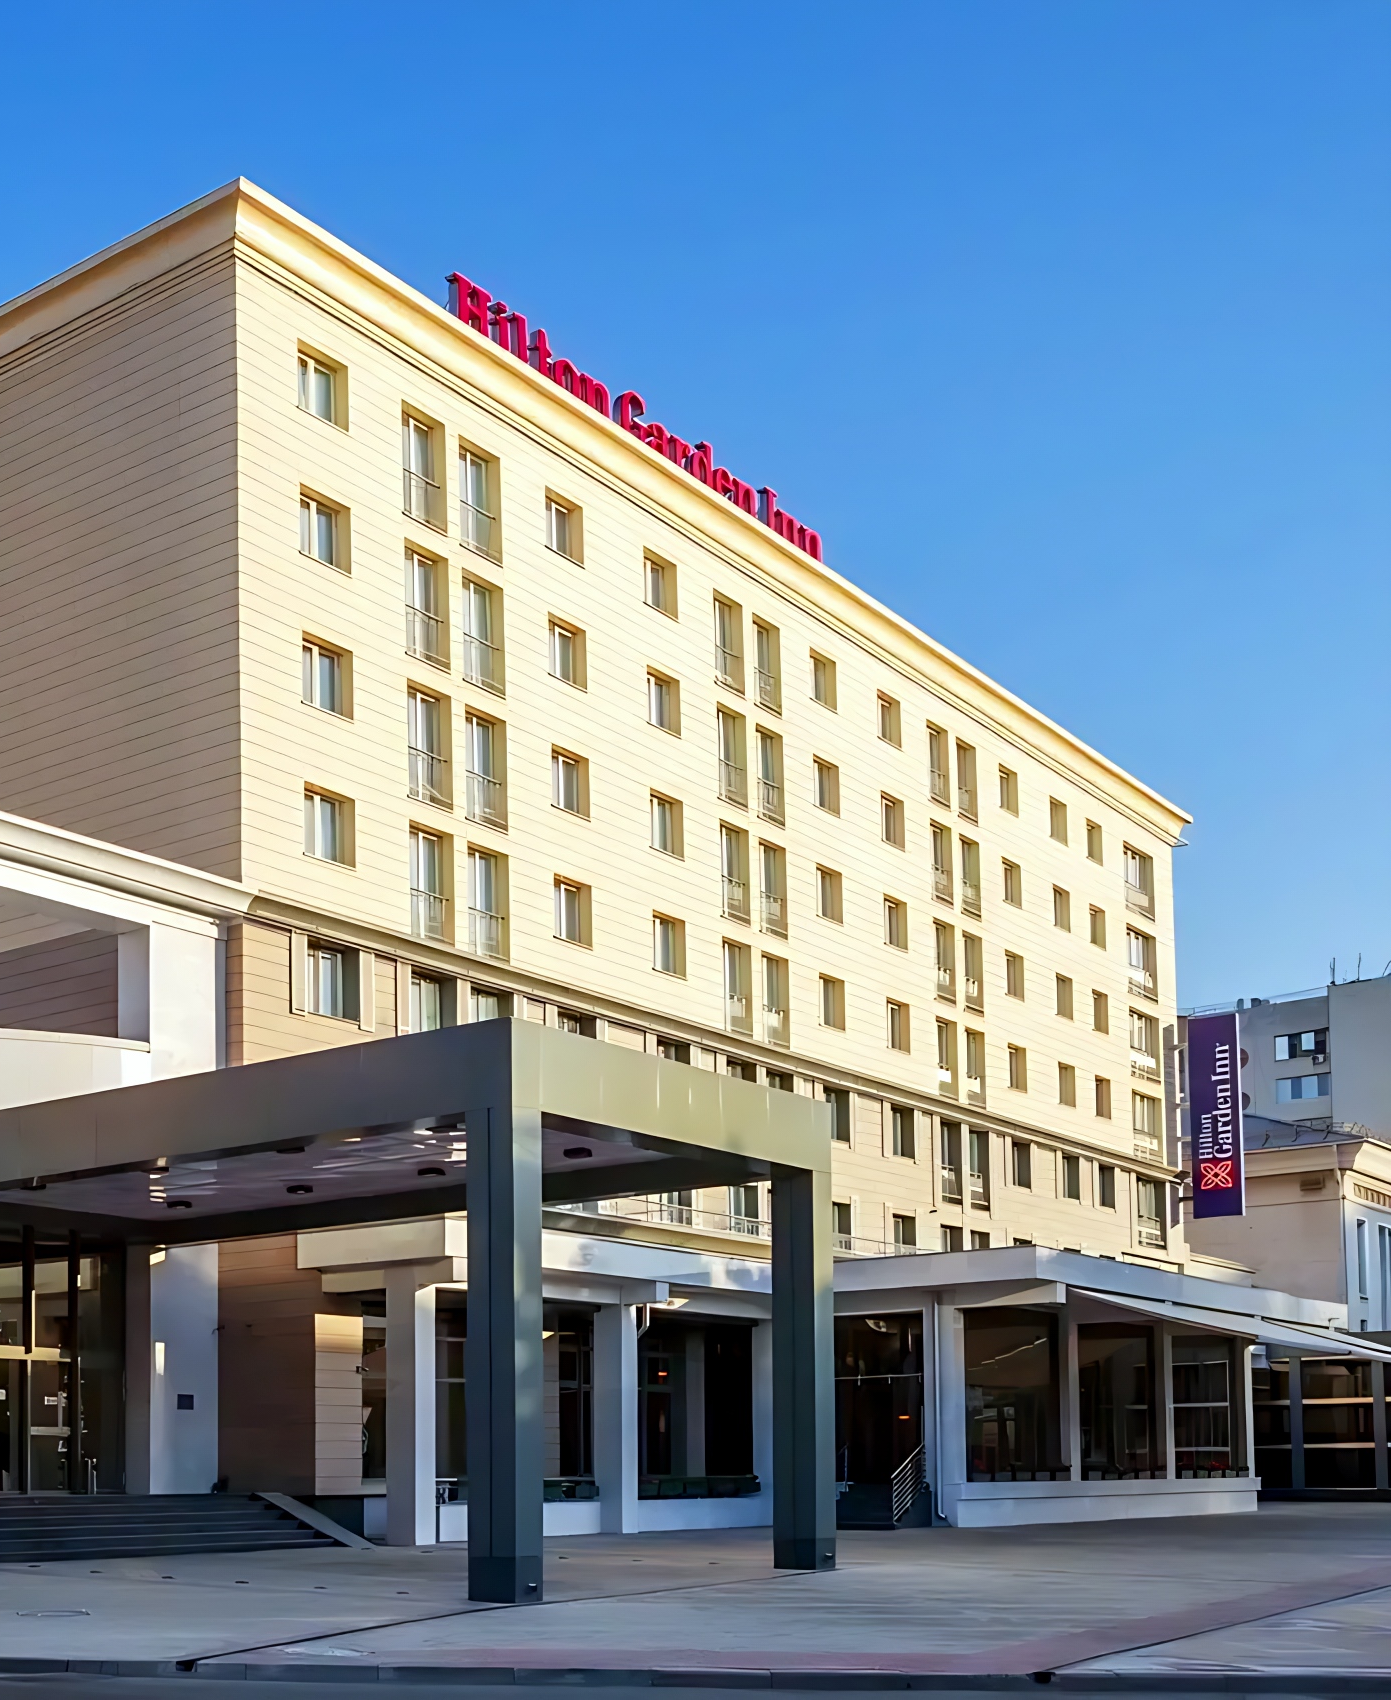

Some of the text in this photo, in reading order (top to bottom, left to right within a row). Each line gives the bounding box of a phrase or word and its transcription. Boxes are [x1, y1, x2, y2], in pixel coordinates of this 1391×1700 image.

[445, 271, 822, 563] Hilton Garden Inn
[1211, 1044, 1233, 1159] Garden Inn
